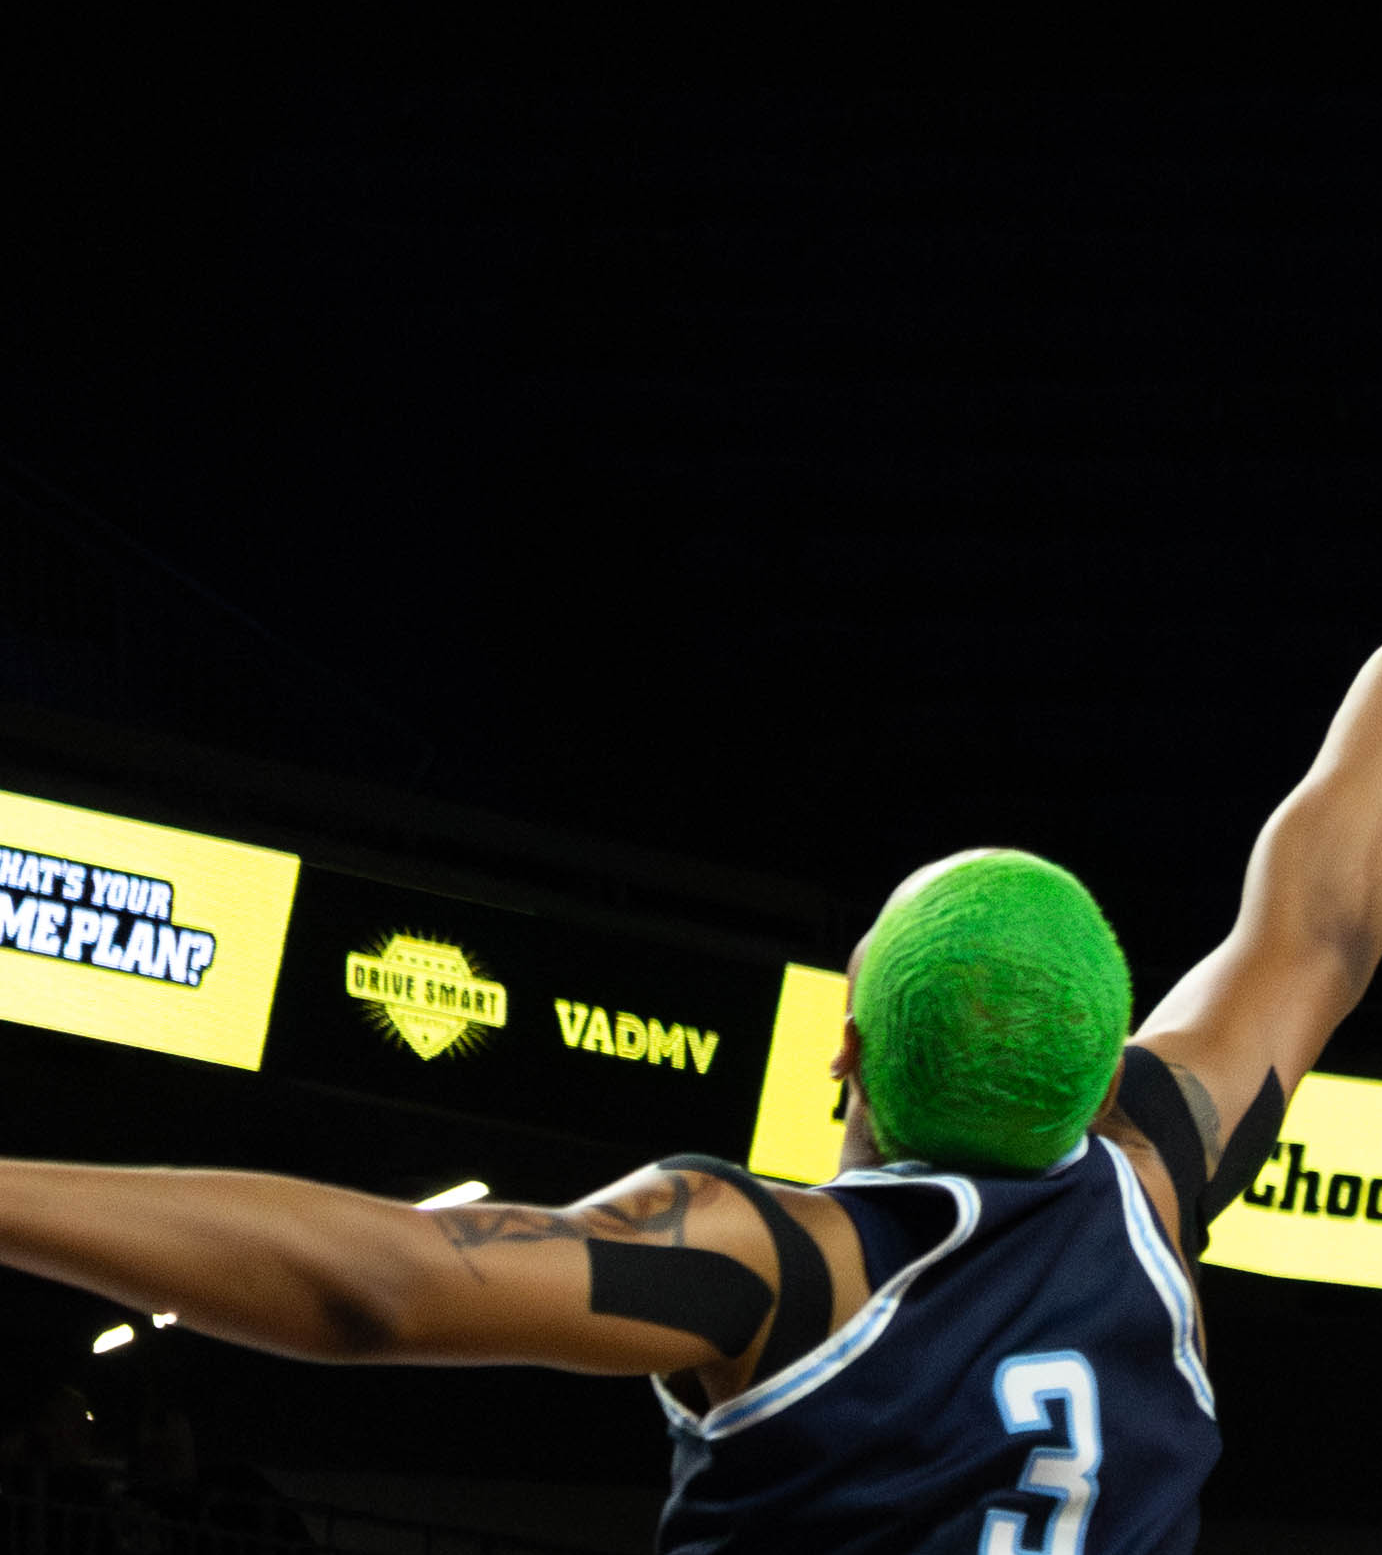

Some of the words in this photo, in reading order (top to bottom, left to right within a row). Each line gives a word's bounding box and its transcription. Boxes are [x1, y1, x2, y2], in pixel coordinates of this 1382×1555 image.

[0, 849, 87, 902] HAT'S
[90, 868, 173, 921] YOUR
[0, 891, 67, 957] ME
[63, 906, 215, 988] PLAN?
[354, 964, 416, 1003] DRIVE
[425, 981, 499, 1018] SMART
[555, 998, 720, 1074] VADMV
